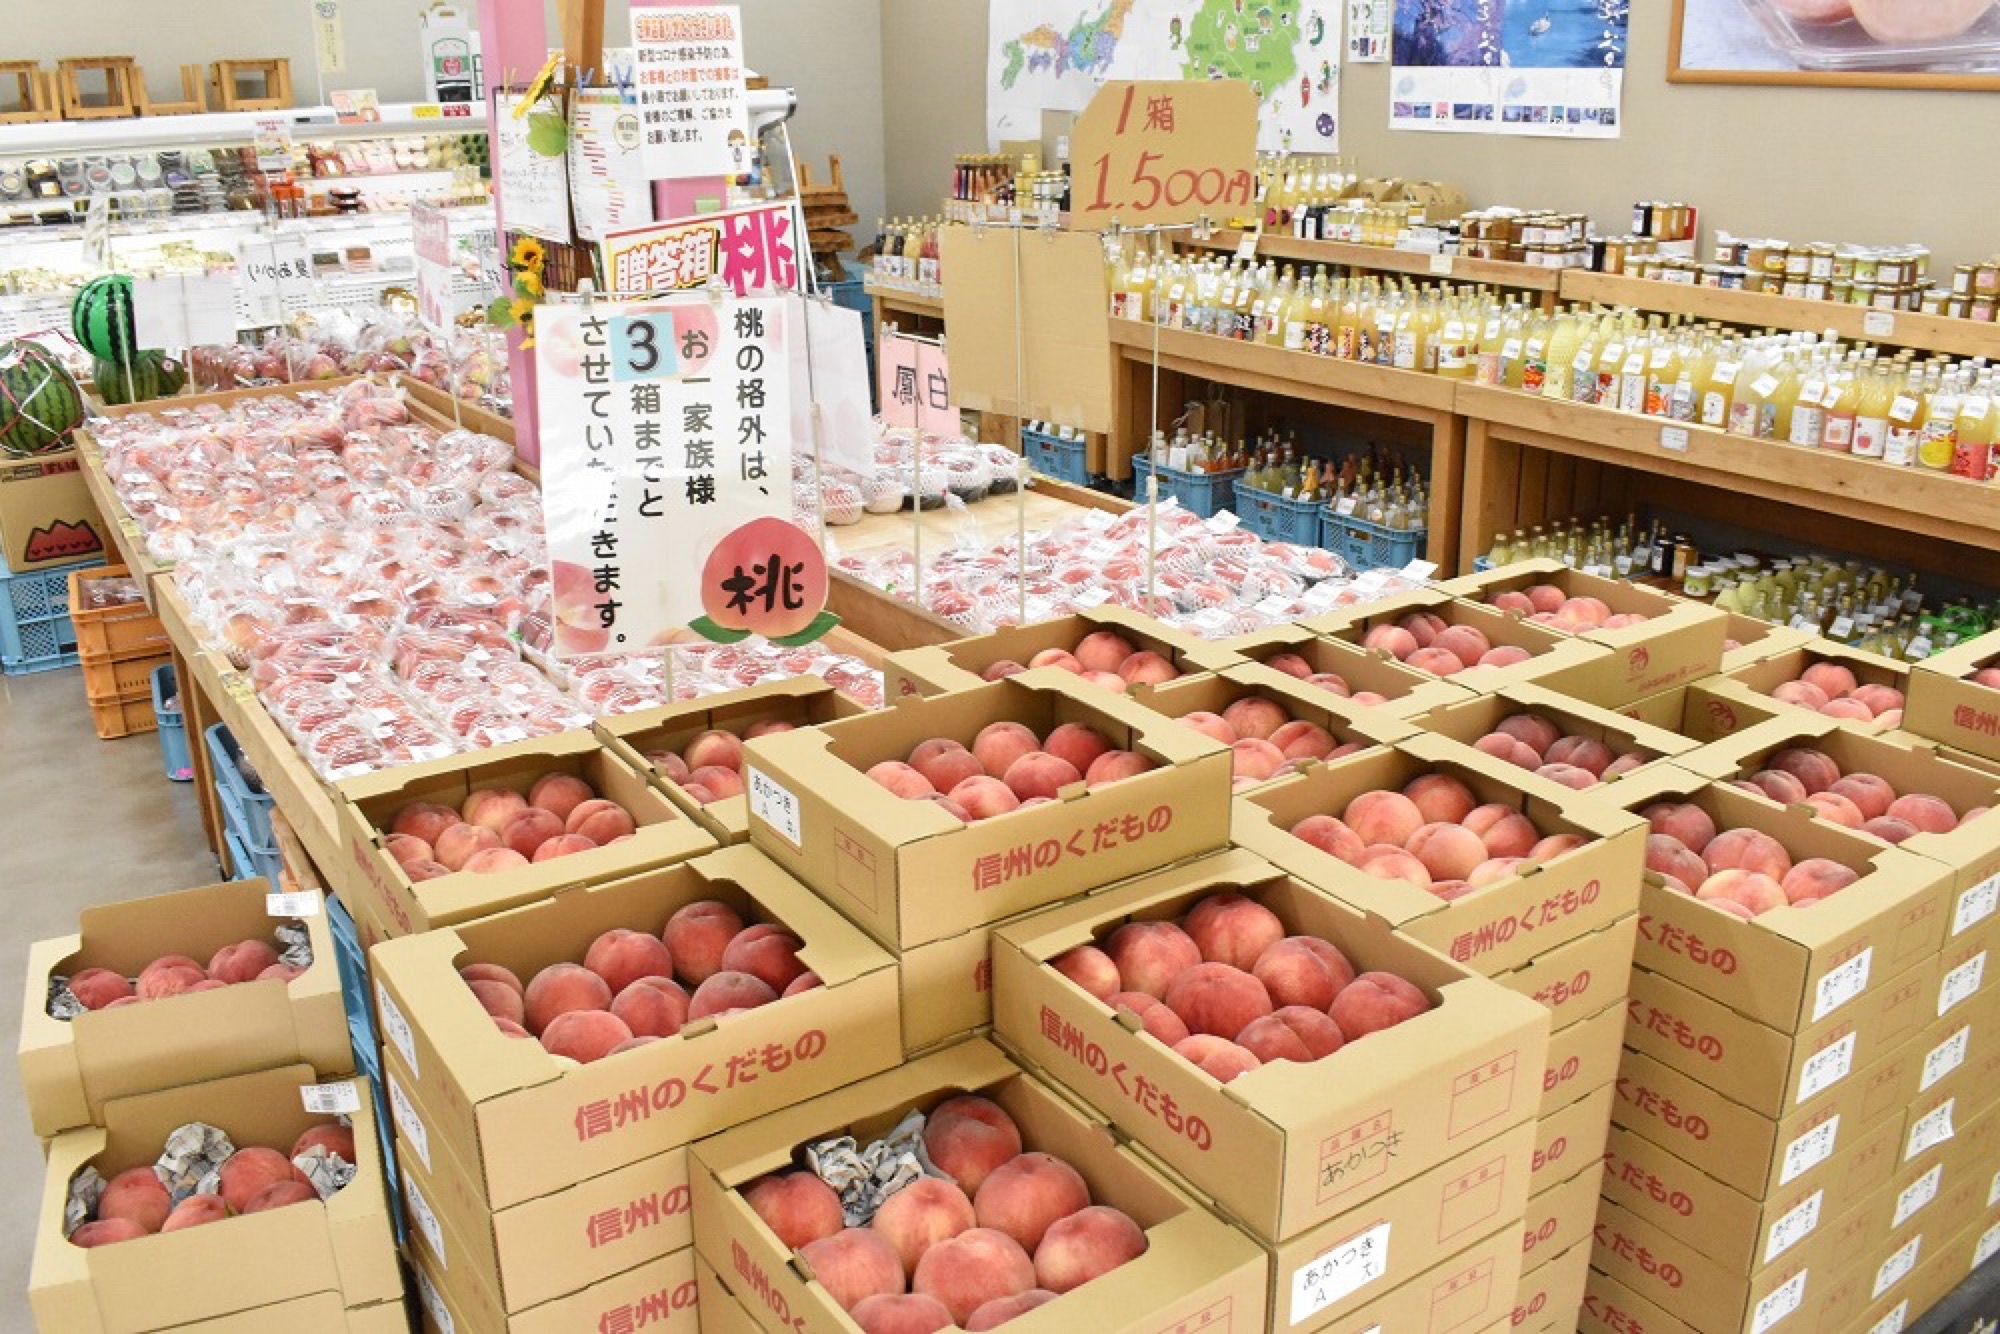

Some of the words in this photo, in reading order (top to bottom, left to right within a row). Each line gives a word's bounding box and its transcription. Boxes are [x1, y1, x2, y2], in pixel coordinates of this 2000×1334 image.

[1115, 84, 1174, 135] 1箱
[615, 228, 713, 299] 贈答箱
[718, 209, 797, 298] 桃
[624, 319, 665, 518] 3箱までと
[681, 330, 716, 505] お一家族様
[733, 307, 769, 496] 桃の格外は、
[579, 315, 627, 644] させていきます。
[721, 553, 806, 616] 桃
[1954, 704, 2000, 737] 信州
[972, 804, 1173, 891] 信州のくだもの
[1450, 879, 1601, 962] 信州のくだもの
[1638, 915, 1737, 975] くだもの
[1628, 1000, 1723, 1061] くだもの
[574, 1029, 827, 1142] 信州のくだもの
[1040, 1004, 1212, 1151] 信州のくだもの
[1322, 1130, 1405, 1187] あかつき
[586, 1184, 691, 1248] 信州の
[1303, 1237, 1375, 1292] あかつき
[1314, 1288, 1327, 1308] A
[598, 1280, 699, 1334] 信州の
